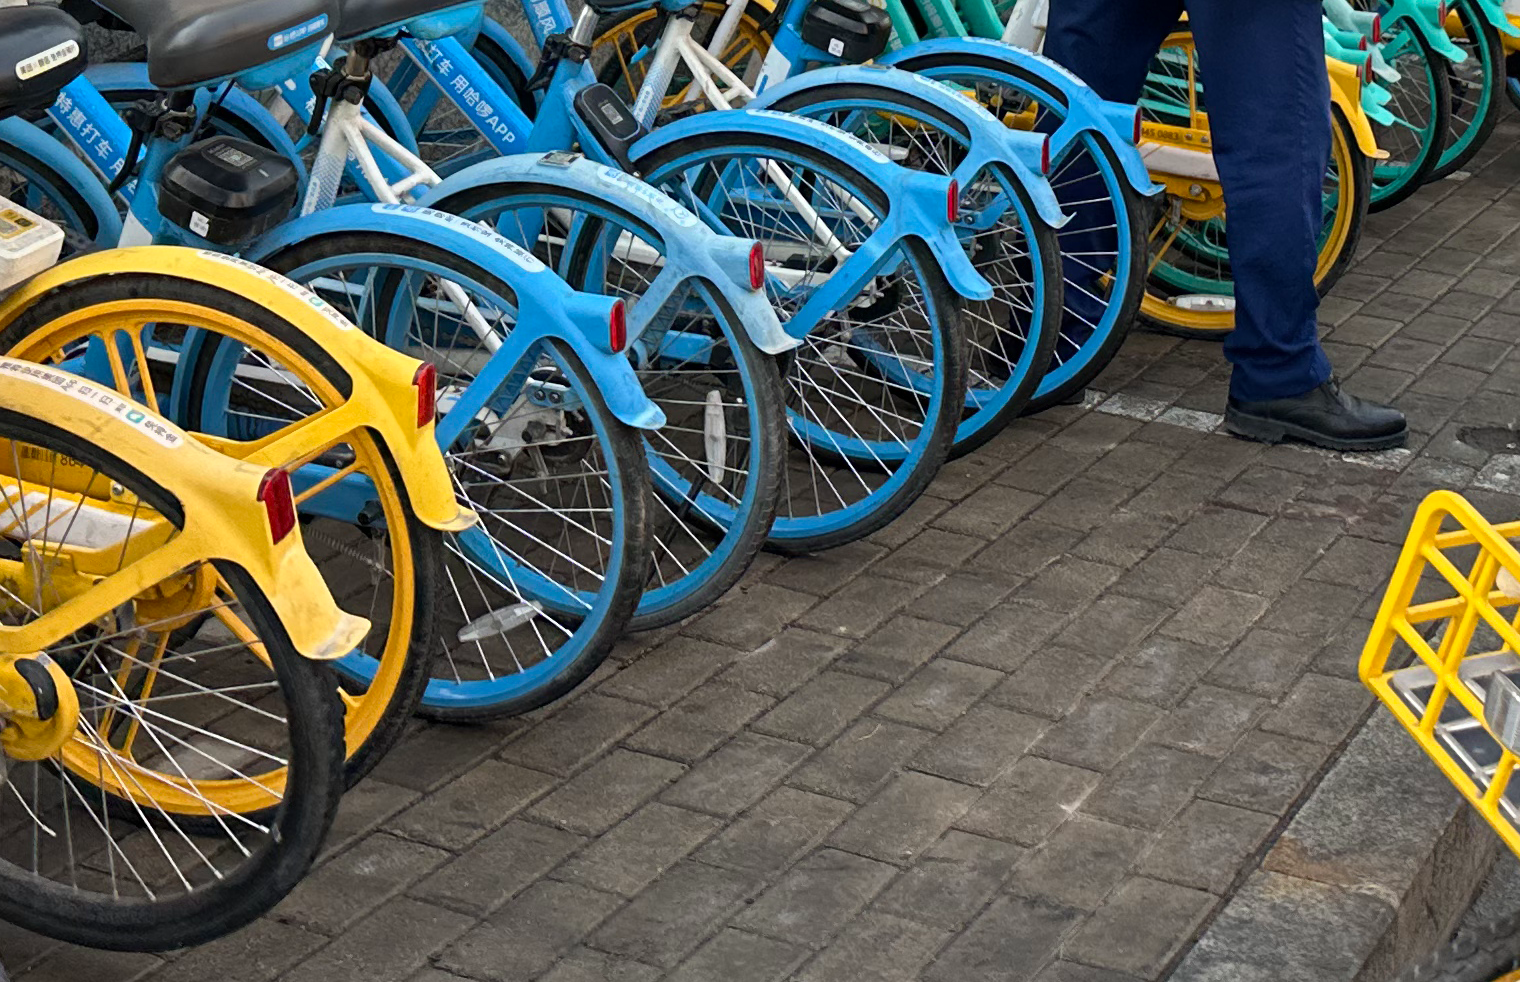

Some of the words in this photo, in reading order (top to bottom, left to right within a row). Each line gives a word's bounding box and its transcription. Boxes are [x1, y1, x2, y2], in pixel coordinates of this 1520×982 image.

[54, 91, 114, 160] 特惠打车
[450, 73, 516, 144] 用哈啰APP
